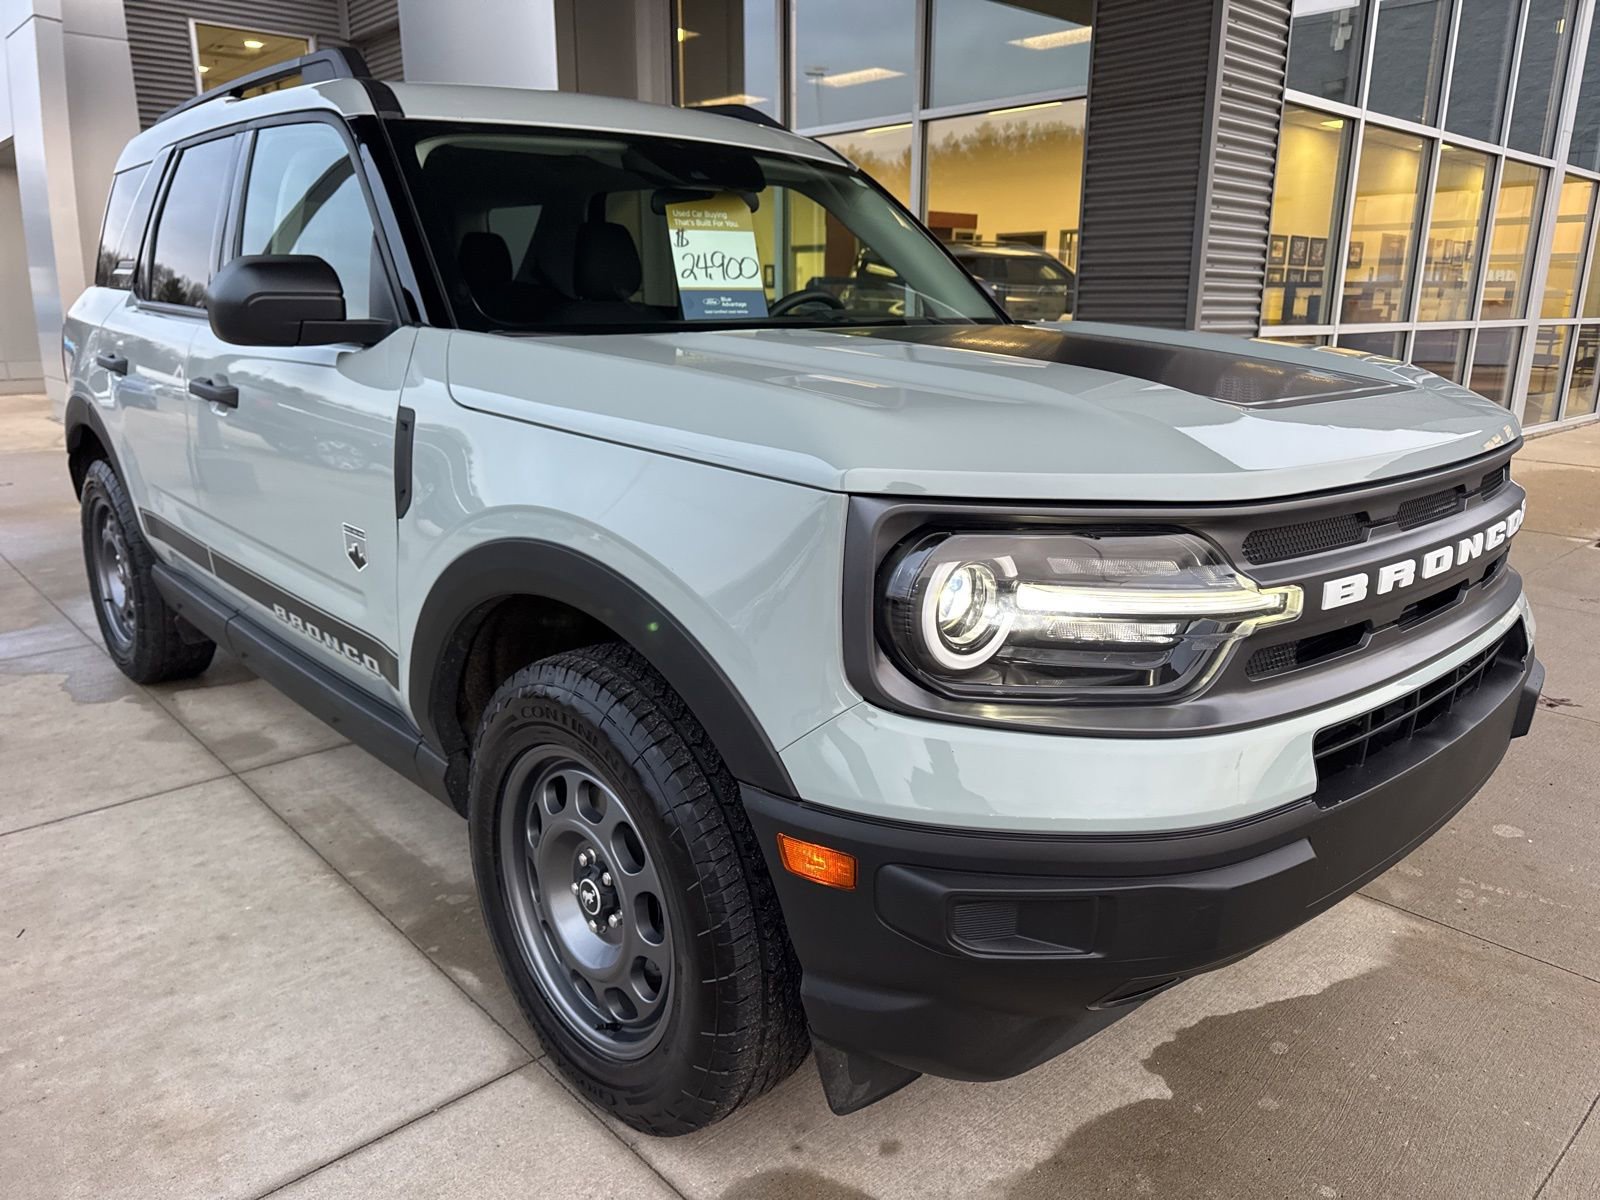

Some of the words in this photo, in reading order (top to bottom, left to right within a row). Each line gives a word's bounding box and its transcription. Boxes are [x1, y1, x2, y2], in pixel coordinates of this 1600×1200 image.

[672, 209, 690, 217] Used
[692, 210, 702, 218] Car
[704, 210, 728, 219] Buying
[674, 218, 695, 226] That's
[712, 219, 723, 227] For
[681, 250, 759, 280] 24,900
[1321, 498, 1527, 610] BRONCO
[273, 603, 382, 677] BRONCO
